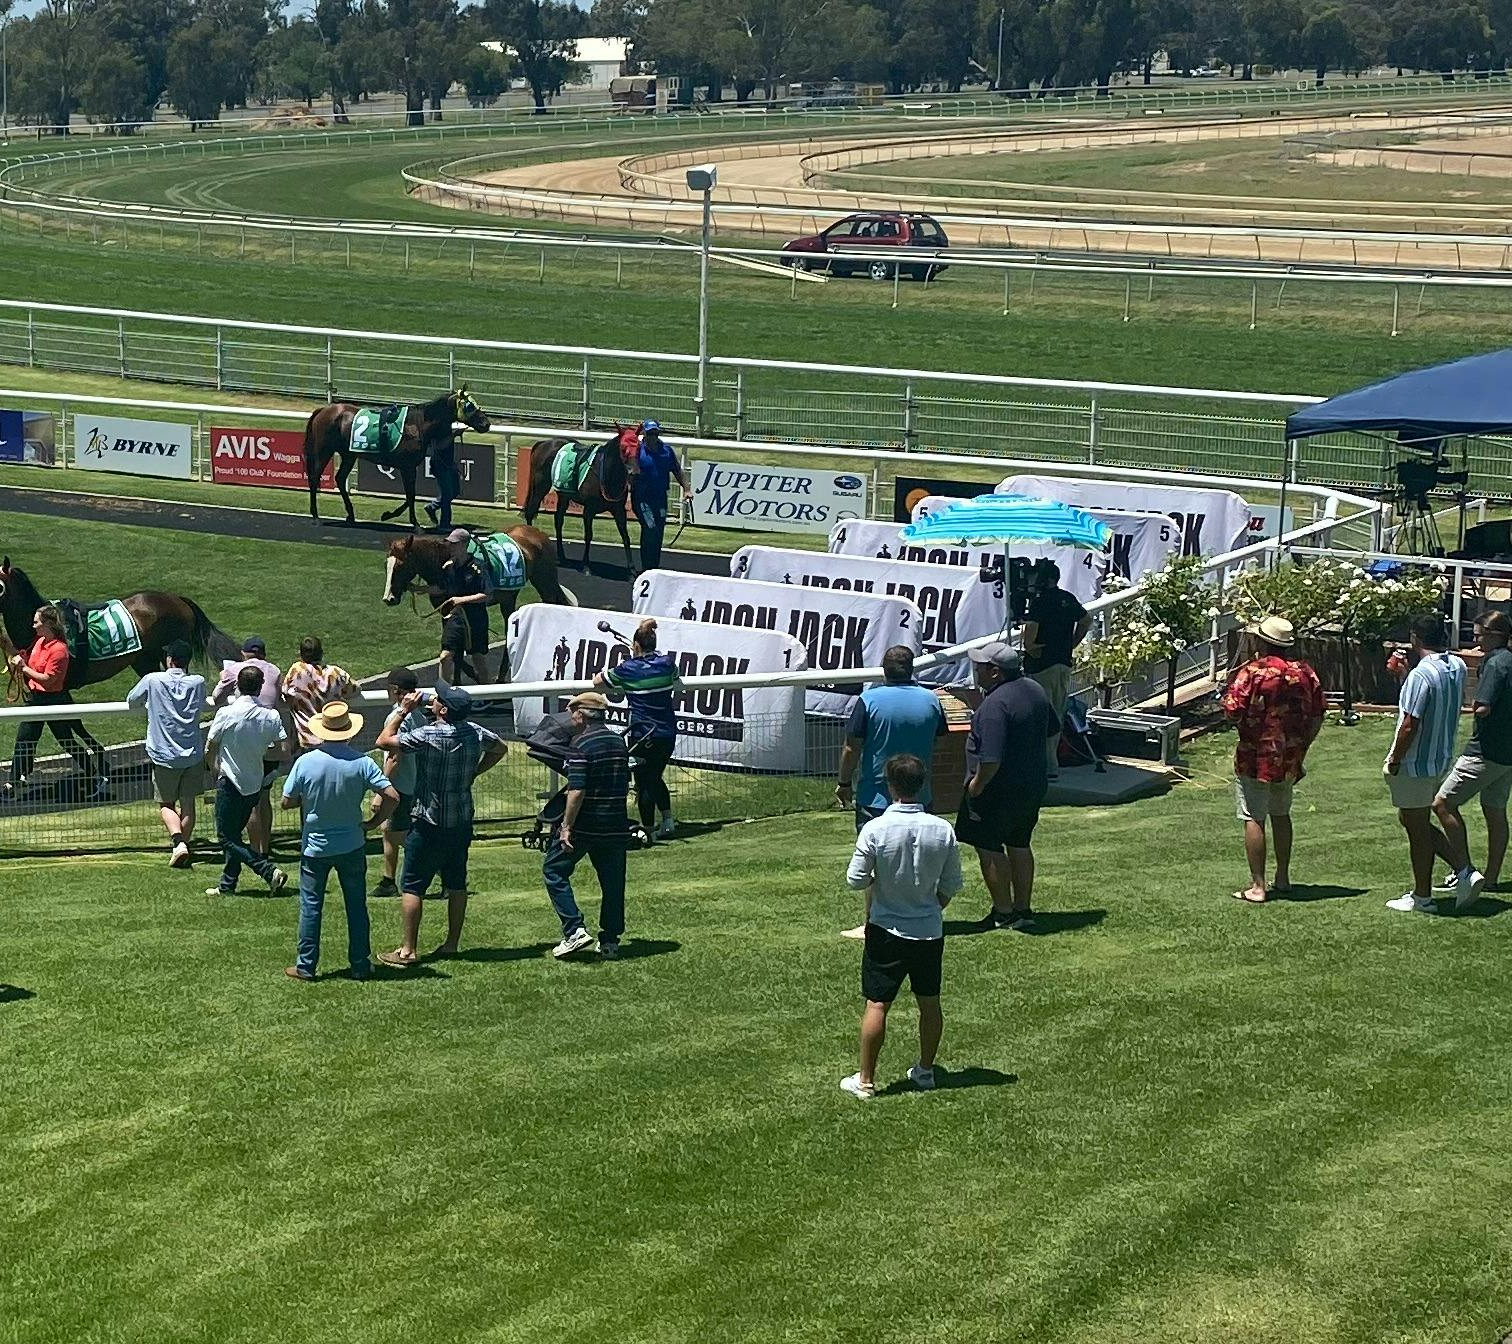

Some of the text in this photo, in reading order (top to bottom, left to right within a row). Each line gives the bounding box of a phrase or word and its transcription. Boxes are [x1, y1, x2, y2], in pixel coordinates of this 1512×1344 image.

[354, 415, 370, 443] 2
[112, 438, 180, 457] BYRNE
[215, 435, 271, 460] AVIS
[273, 453, 301, 464] Wagga
[214, 466, 233, 475] Proud
[267, 469, 302, 479] Foundation
[695, 462, 812, 494] JUPITER
[832, 490, 862, 498] SUBARU
[704, 488, 830, 522] MOTORS
[918, 506, 928, 520] 5
[836, 527, 847, 544] 4
[1159, 525, 1170, 542] 5
[737, 555, 748, 573] 3
[1082, 552, 1093, 569] 4
[639, 579, 650, 598] 2
[992, 580, 1004, 600] 3
[511, 618, 520, 638] 1
[899, 608, 911, 629] 2
[783, 648, 792, 669] 1
